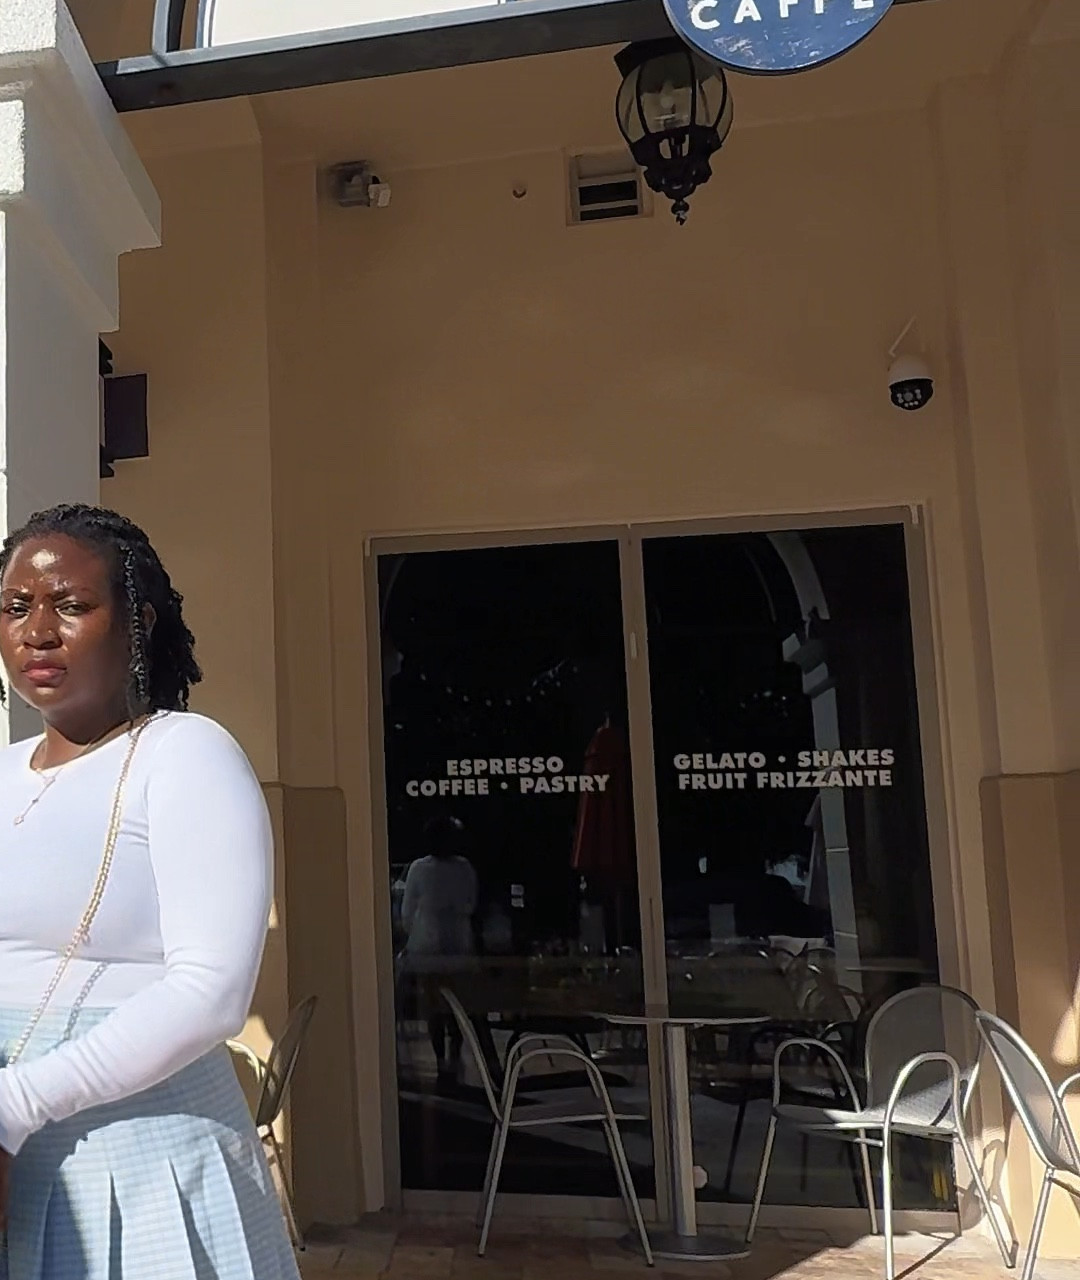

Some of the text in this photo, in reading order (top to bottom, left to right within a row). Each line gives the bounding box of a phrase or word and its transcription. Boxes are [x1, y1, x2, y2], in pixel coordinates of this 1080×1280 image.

[446, 756, 564, 776] ESPRESSO
[673, 748, 895, 770] GELATO SHAKES
[405, 774, 610, 797] COFFEE PASTRY
[678, 769, 893, 791] FRUIT FRIZZANTE
